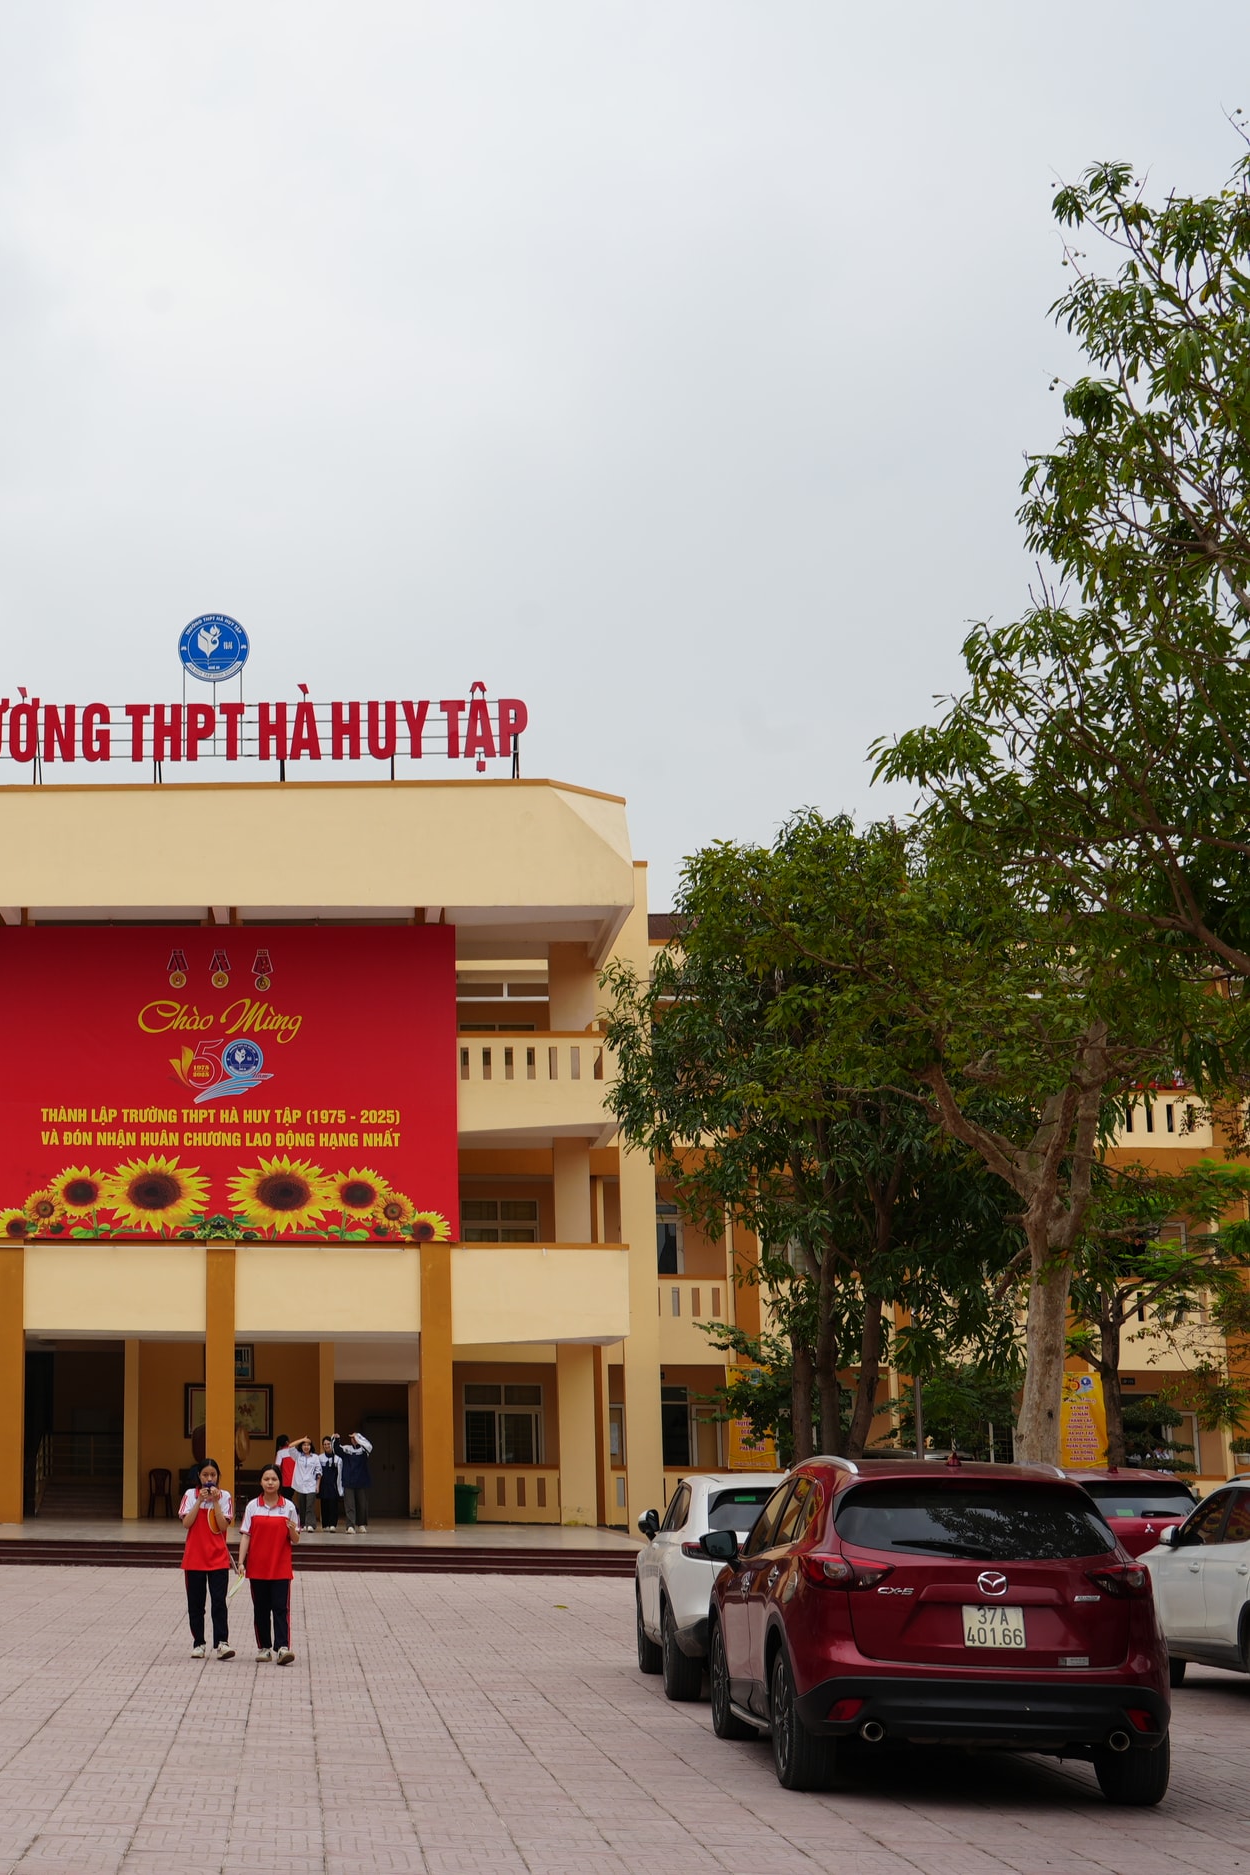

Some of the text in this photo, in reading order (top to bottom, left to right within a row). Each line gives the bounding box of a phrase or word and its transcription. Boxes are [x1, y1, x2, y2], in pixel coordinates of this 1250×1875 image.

[125, 702, 245, 763] THPT
[258, 683, 322, 761] HÀ
[331, 700, 430, 760] HUY
[440, 681, 528, 772] TẬP
[137, 998, 303, 1044] Chào Mừng
[41, 1106, 87, 1123] THÀNH
[91, 1106, 117, 1126] LẬP
[121, 1106, 178, 1123] TRƯỜNG
[181, 1109, 216, 1123] THPT
[220, 1106, 239, 1123] HÀ
[243, 1109, 271, 1124] HUY
[275, 1106, 302, 1126] TẬP
[306, 1109, 346, 1125] (1975
[360, 1109, 400, 1125] 2025)
[41, 1128, 400, 1150] VÀ ĐÓN NHẬN HUÂN CHƯƠNG LAO ĐỘNG HẠNG NHẤT
[877, 1586, 914, 1596] CX-5
[977, 1607, 1010, 1626] 37A
[966, 1627, 1024, 1647] 401.66
